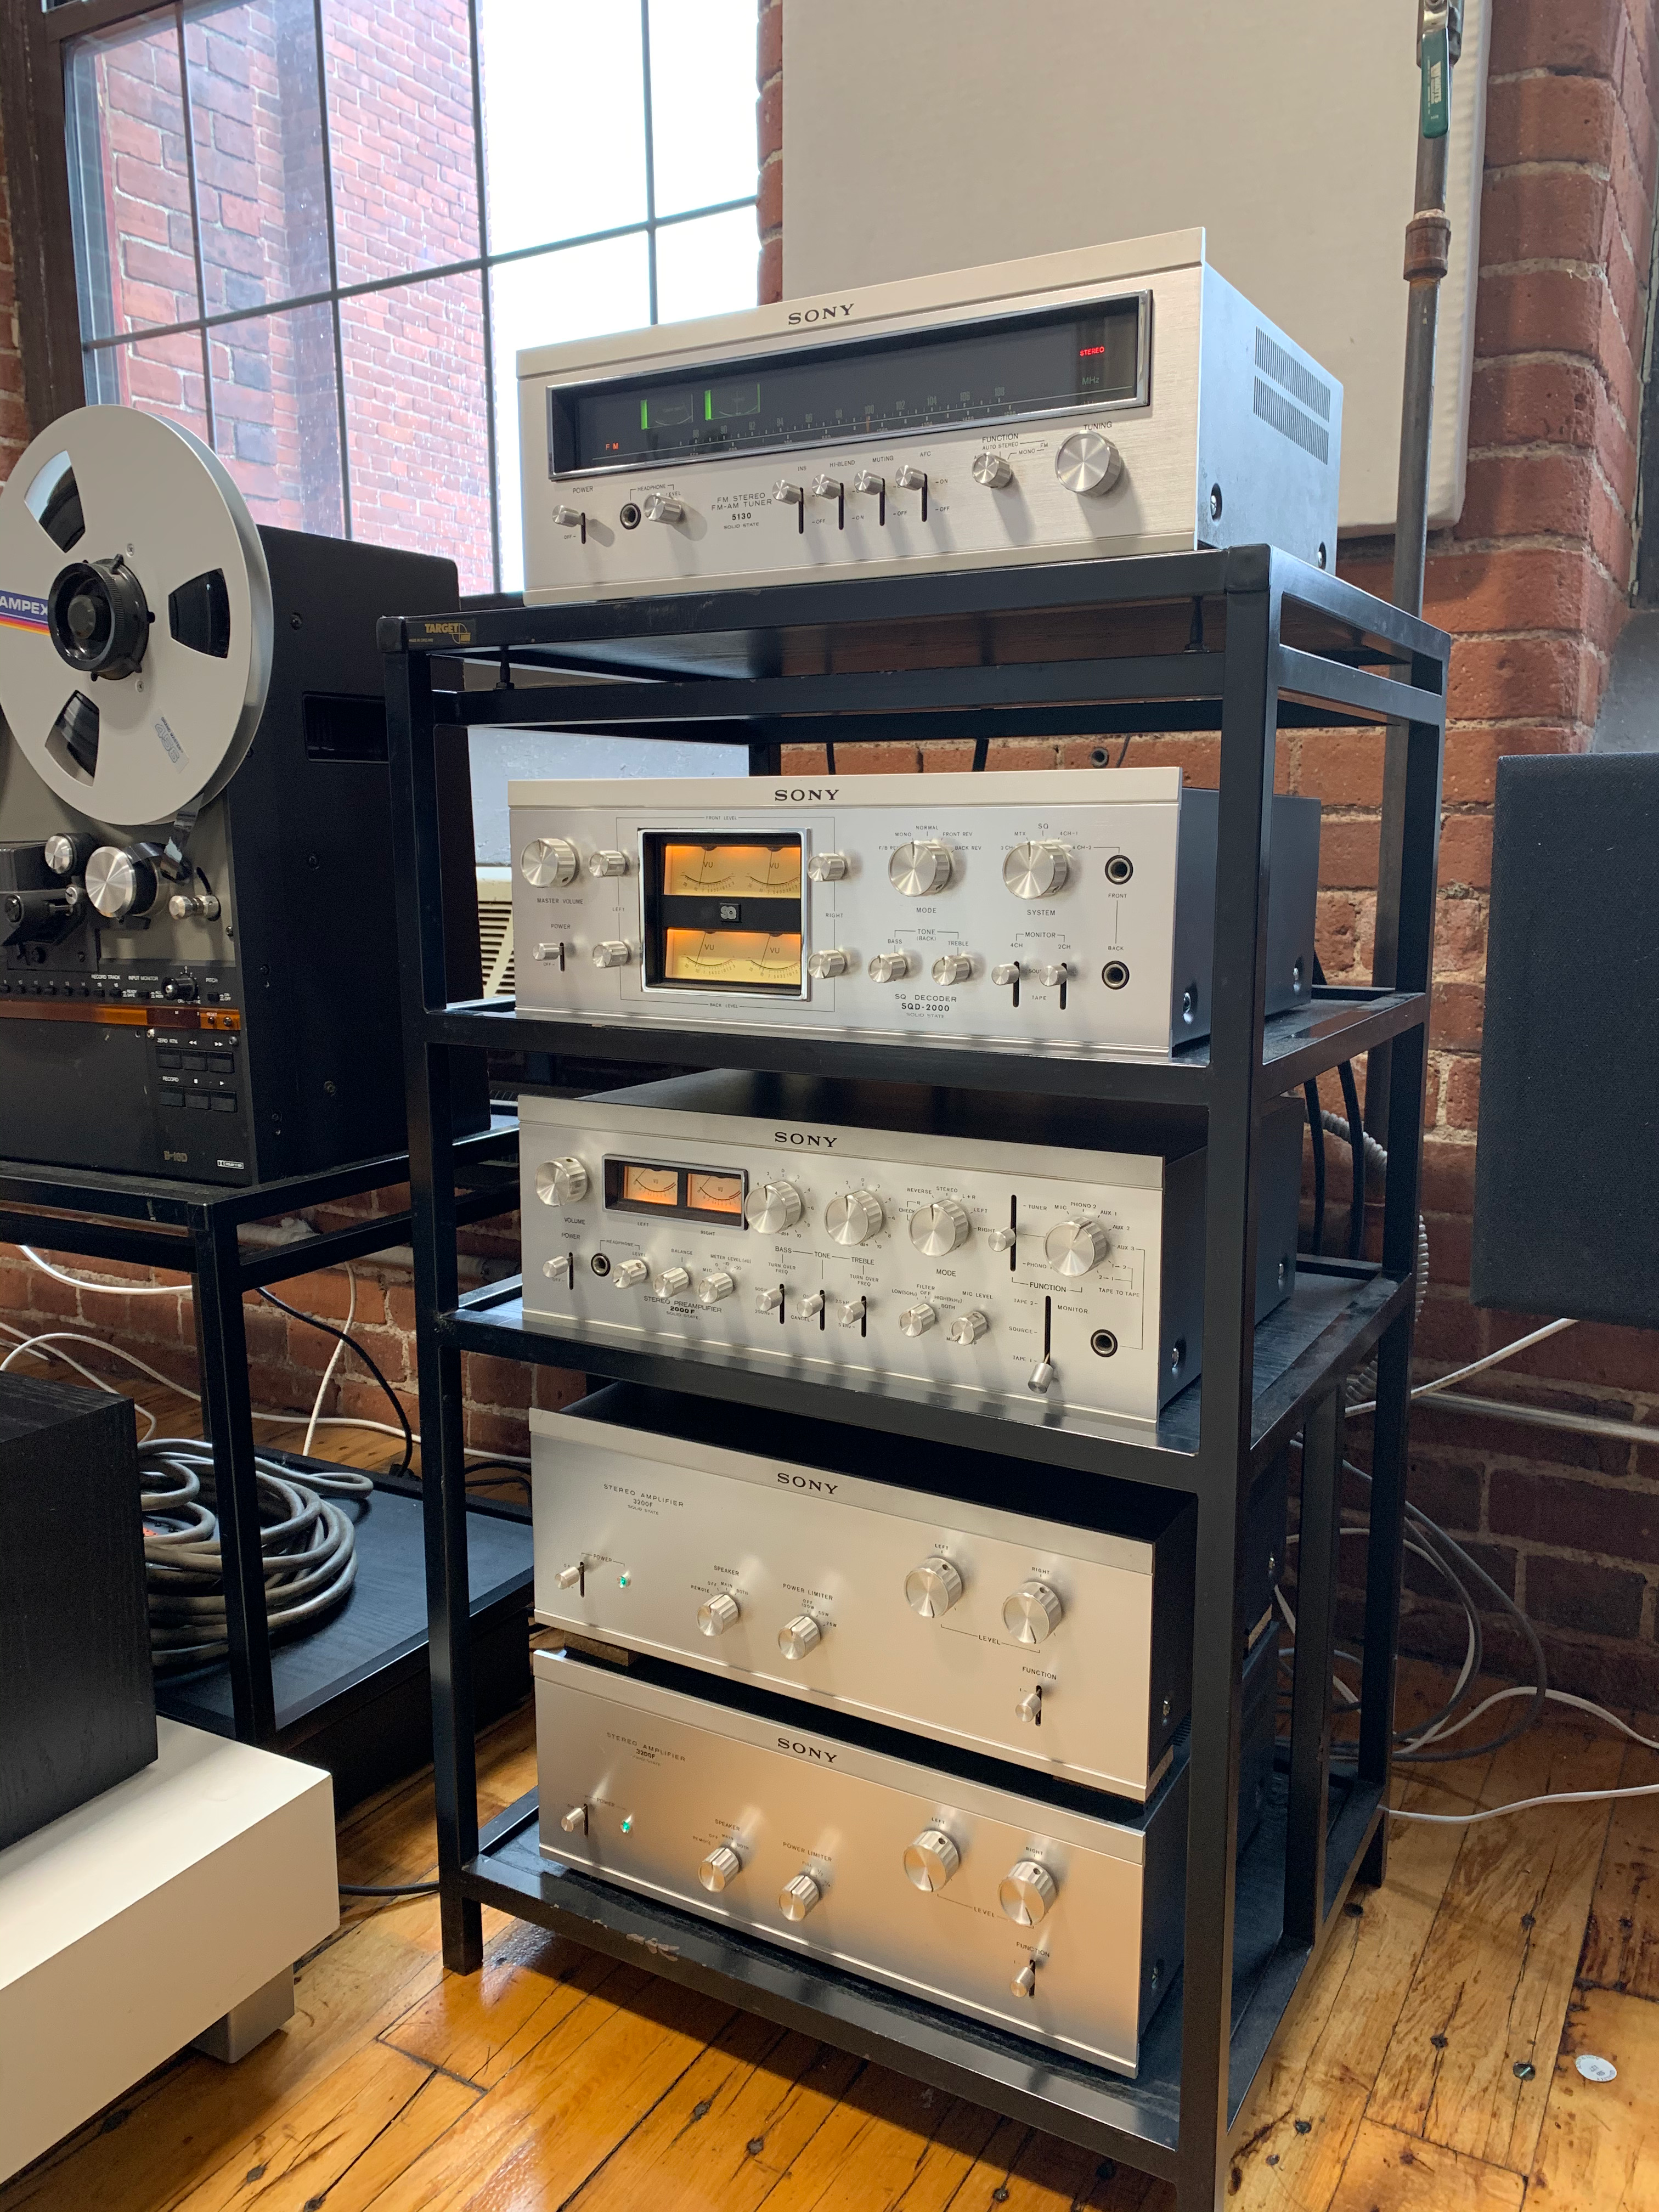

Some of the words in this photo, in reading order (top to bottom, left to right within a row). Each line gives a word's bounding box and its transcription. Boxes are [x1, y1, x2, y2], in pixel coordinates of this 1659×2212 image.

[788, 303, 855, 325] SONY
[1079, 346, 1105, 357] STEREO
[1081, 376, 1100, 385] MHz
[748, 421, 756, 431] 92
[776, 417, 784, 427] 94
[805, 413, 813, 423] 96
[865, 404, 874, 415] 100
[895, 400, 905, 410] 102
[927, 396, 938, 406] 104
[960, 391, 970, 402] 106
[994, 386, 1006, 397] 108
[1084, 421, 1113, 431] TUNING
[981, 432, 1019, 444] FUNCTION
[605, 442, 619, 450] FM
[830, 460, 855, 468] HI-BLEND
[572, 486, 594, 494] POWER
[637, 483, 666, 492] HEADPHONE
[732, 492, 766, 503] STEREO
[711, 502, 739, 511] FM-AM
[743, 498, 772, 508] TUNER
[731, 512, 752, 521] 5130
[0, 595, 48, 616] AMPEX
[425, 623, 459, 634] TARGET
[155, 723, 180, 763] 456
[775, 789, 840, 802] SONY
[720, 906, 737, 920] SQ
[914, 994, 957, 1002] DECODER
[901, 1003, 950, 1012] SQD-2000
[775, 1131, 838, 1148] SONY
[907, 1187, 932, 1195] REVERSE
[563, 1217, 586, 1225] VOLUME
[606, 1239, 634, 1247] HEADPHONE
[814, 1251, 831, 1259] TONE
[850, 1256, 875, 1265] TREBLE
[936, 1268, 956, 1277] MODE
[1029, 1282, 1066, 1293] FUNCTION
[643, 1295, 670, 1305] STEREO
[674, 1300, 722, 1313] PREAMPLIFIER
[1057, 1305, 1088, 1314] MONITOR
[1008, 1325, 1033, 1334] SOURCE
[777, 1472, 838, 1495] SONY
[603, 1483, 635, 1496] STEREO
[640, 1492, 684, 1508] AMPLIFIER
[633, 1498, 653, 1508] 3200F
[593, 1553, 612, 1563] POWER
[714, 1565, 740, 1577] SPEAKER
[1031, 1566, 1050, 1575] RIGHT
[690, 1584, 710, 1594] REMOTE
[782, 1583, 805, 1593] POWER
[808, 1589, 833, 1601] LIMITER
[978, 1634, 1001, 1646] LEVEL
[1022, 1666, 1057, 1680] FUNCTION
[606, 1731, 637, 1746] STEREO
[642, 1743, 686, 1762] AMPLIFIER
[777, 1737, 838, 1763] SONY
[635, 1748, 656, 1759] 3200F
[596, 1797, 615, 1807] POWER
[715, 1819, 740, 1832] SPEAKER
[932, 1816, 945, 1825] LEFT
[692, 1835, 712, 1846] REMOTE
[783, 1841, 805, 1854] POWER
[808, 1849, 832, 1863] LIMITER
[1025, 1846, 1043, 1856] RIGHT
[973, 1906, 995, 1918] LEVEL
[1016, 1941, 1051, 1958] FUNCTION
